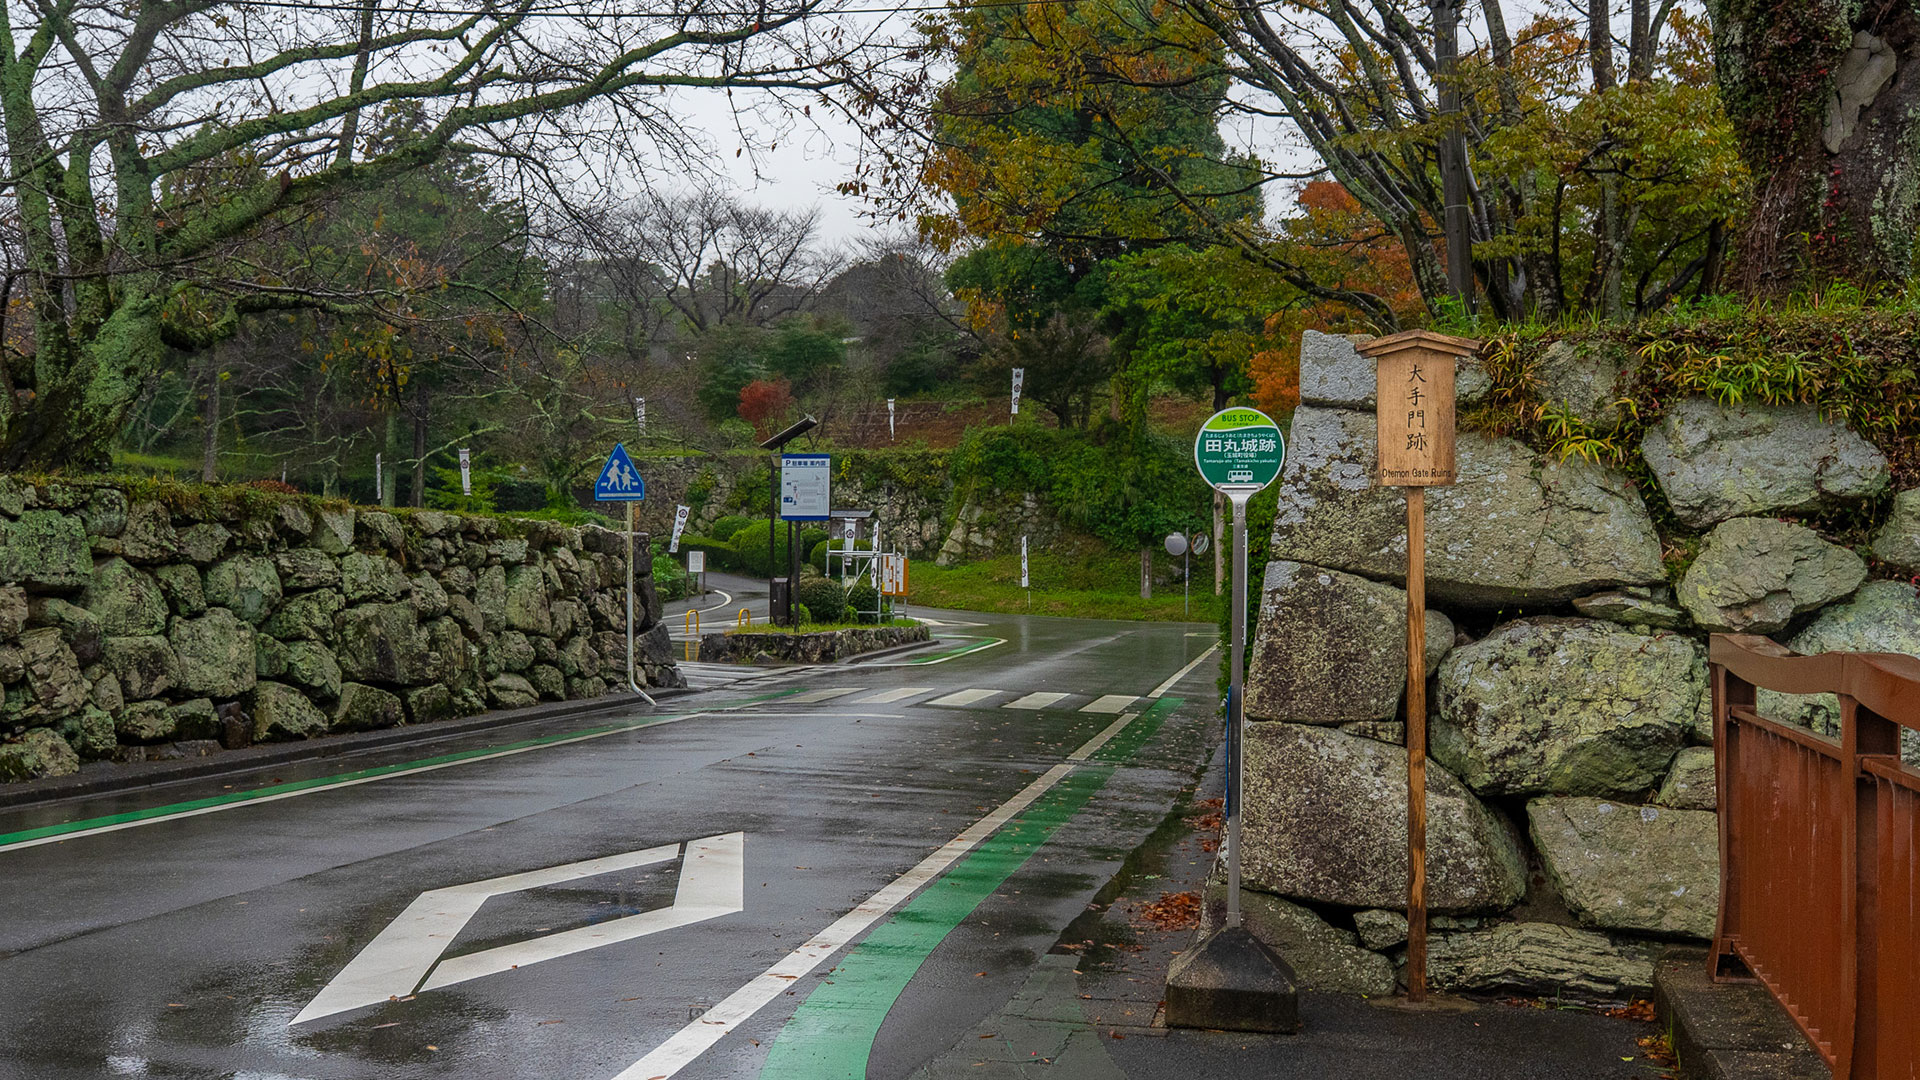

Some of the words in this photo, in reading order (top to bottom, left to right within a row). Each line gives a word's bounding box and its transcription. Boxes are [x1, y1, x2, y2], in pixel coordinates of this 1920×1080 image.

[1406, 364, 1428, 452] 大手門跡
[1206, 439, 1276, 452] 田丸城跡
[1382, 468, 1409, 478] Otemon
[1411, 468, 1429, 478] Gate
[1431, 468, 1451, 478] Ruins
